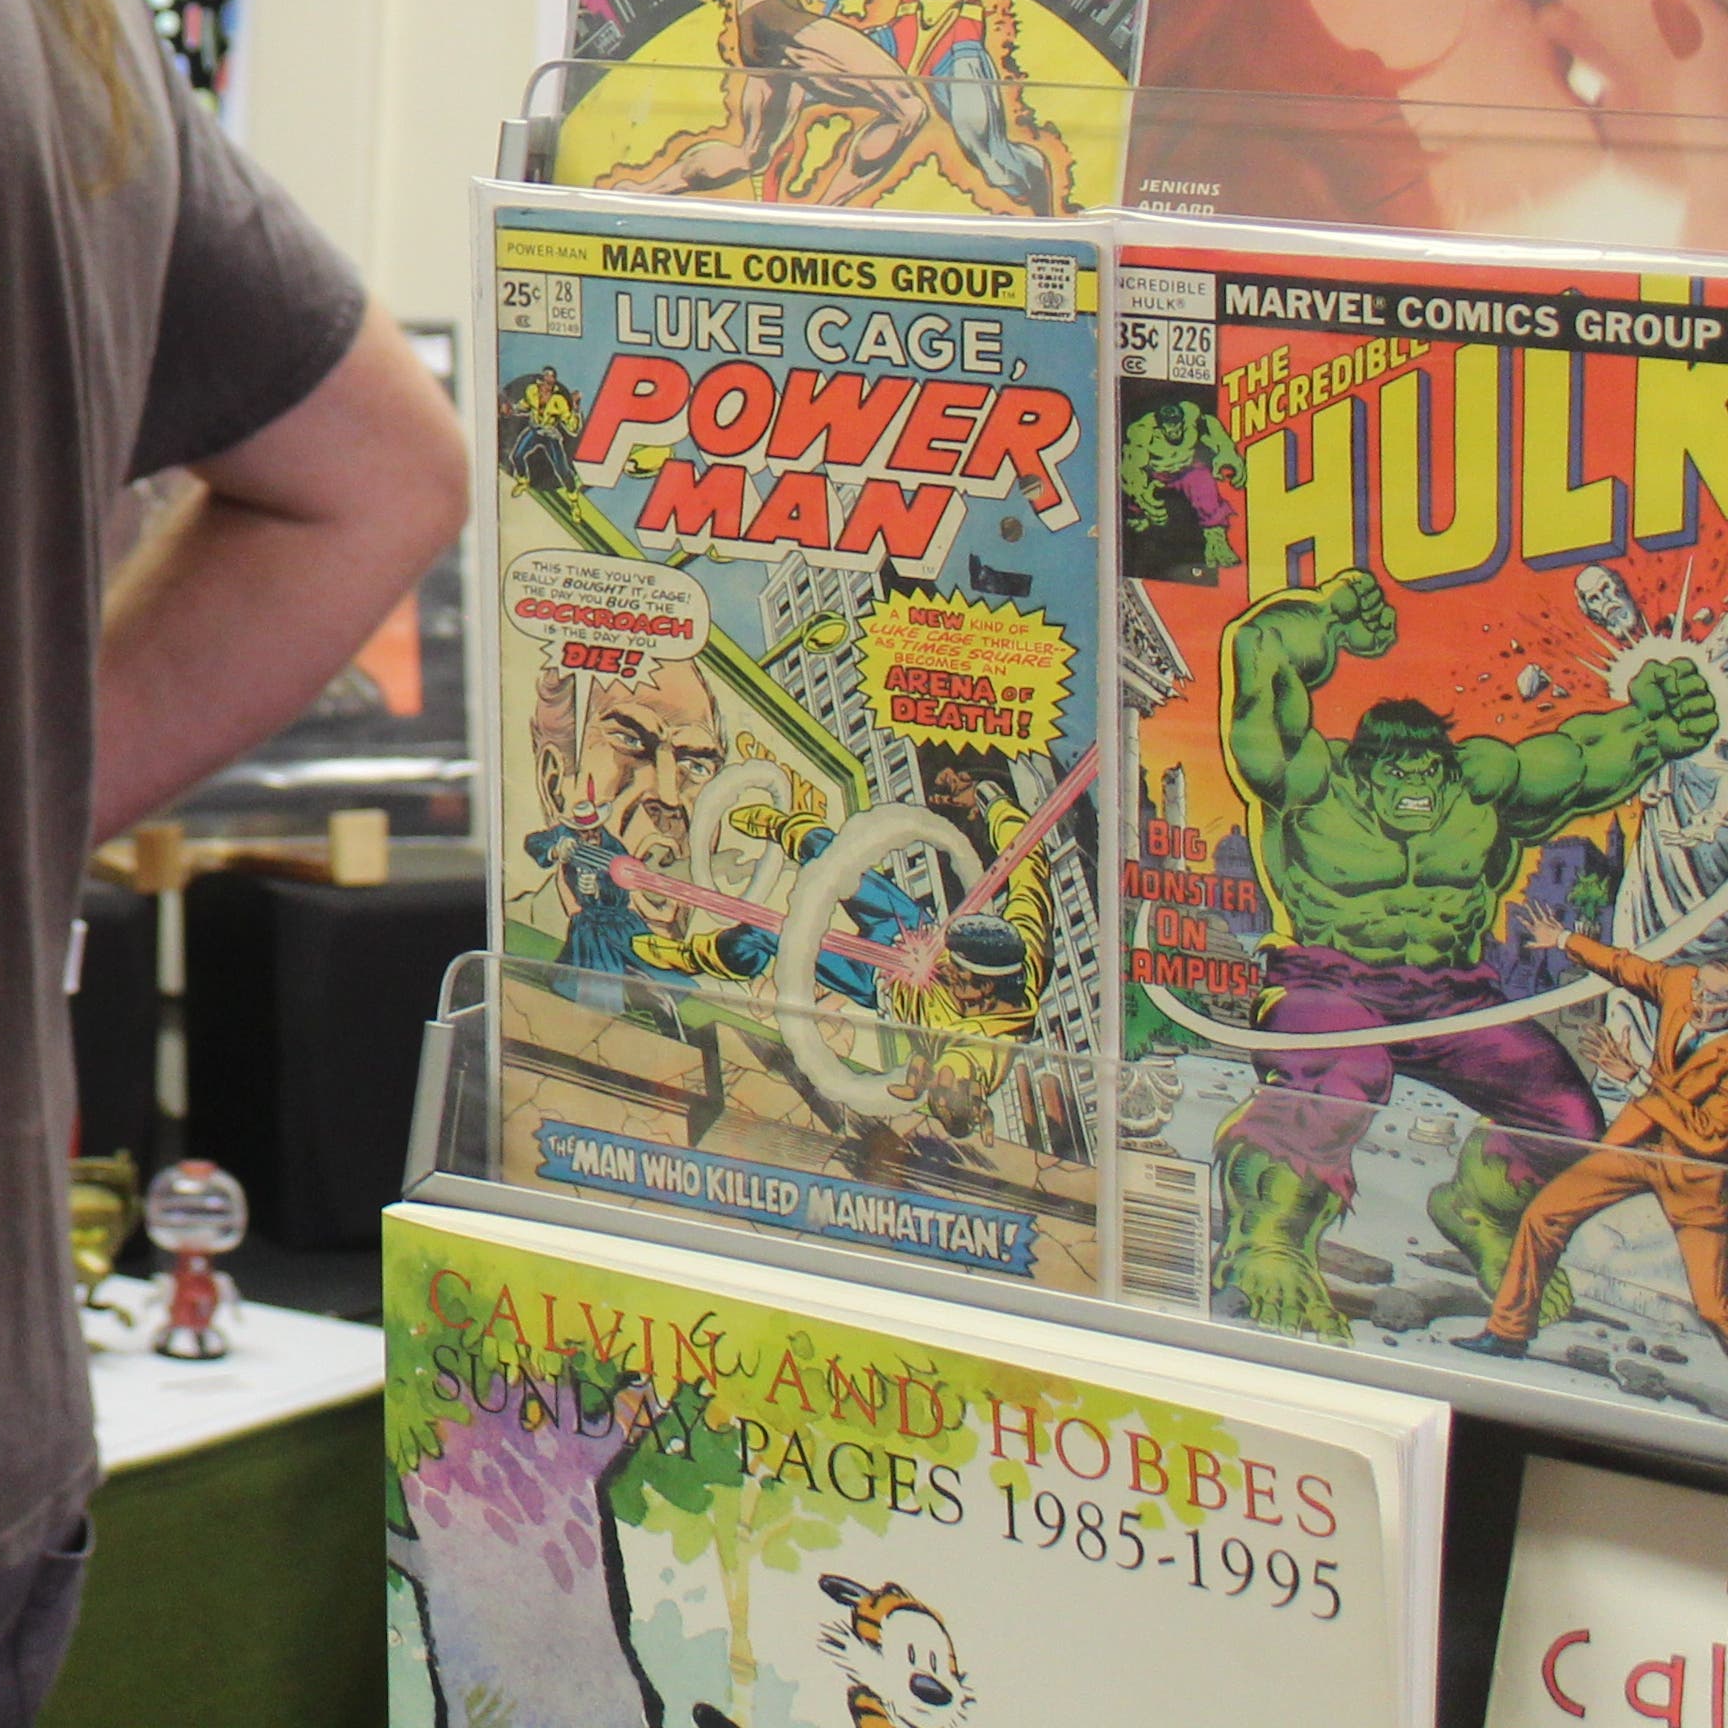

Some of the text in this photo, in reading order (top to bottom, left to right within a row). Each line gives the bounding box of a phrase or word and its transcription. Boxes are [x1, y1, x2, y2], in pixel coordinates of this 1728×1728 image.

[1138, 178, 1222, 197] JENKINS
[506, 241, 1014, 299] POWER-MAN MARVEL COMICS GROUP
[503, 280, 574, 308] 25¢ 28
[552, 307, 577, 319] DEC
[615, 289, 1028, 381] LUKE CAGE,
[1172, 324, 1212, 353] 226
[1396, 296, 1722, 351] COMICS GROUP
[1175, 354, 1207, 368] AUG
[1222, 343, 1291, 405] THE
[1228, 335, 1432, 444] INCREDIBLE
[574, 353, 1081, 528] POWER
[1244, 272, 1728, 606] HULK
[635, 459, 967, 577] MAN
[512, 570, 559, 587] REALLY
[562, 577, 628, 595] BOUGHT
[651, 589, 692, 606] CAGE!
[531, 561, 657, 587] THIS TIME YOU'VE
[514, 598, 694, 640] COCKROACH
[522, 584, 675, 615] THE DAY YOU BUG THE
[544, 624, 657, 649] IS THE DAY YOU
[869, 623, 921, 640] LUKE
[926, 629, 975, 646] CAGE
[889, 606, 1030, 636] A NEW KIND OF
[561, 641, 645, 679] DIE!
[874, 637, 1054, 669] AS TIMES SQUARE
[894, 652, 1008, 677] BECOMES AN
[884, 664, 1036, 704] ARENA OF
[890, 694, 1033, 740] DEATH!
[1147, 818, 1208, 863] BIG
[1155, 907, 1209, 952] ON
[1120, 944, 1260, 999] AMPUS!
[546, 1133, 1020, 1264] THE MAN WHO KILLED MANHATTAN!
[428, 1268, 1341, 1540] CALVIN AND HOBBES
[431, 1343, 1345, 1624] SUNDAY PAGES 1985-1995
